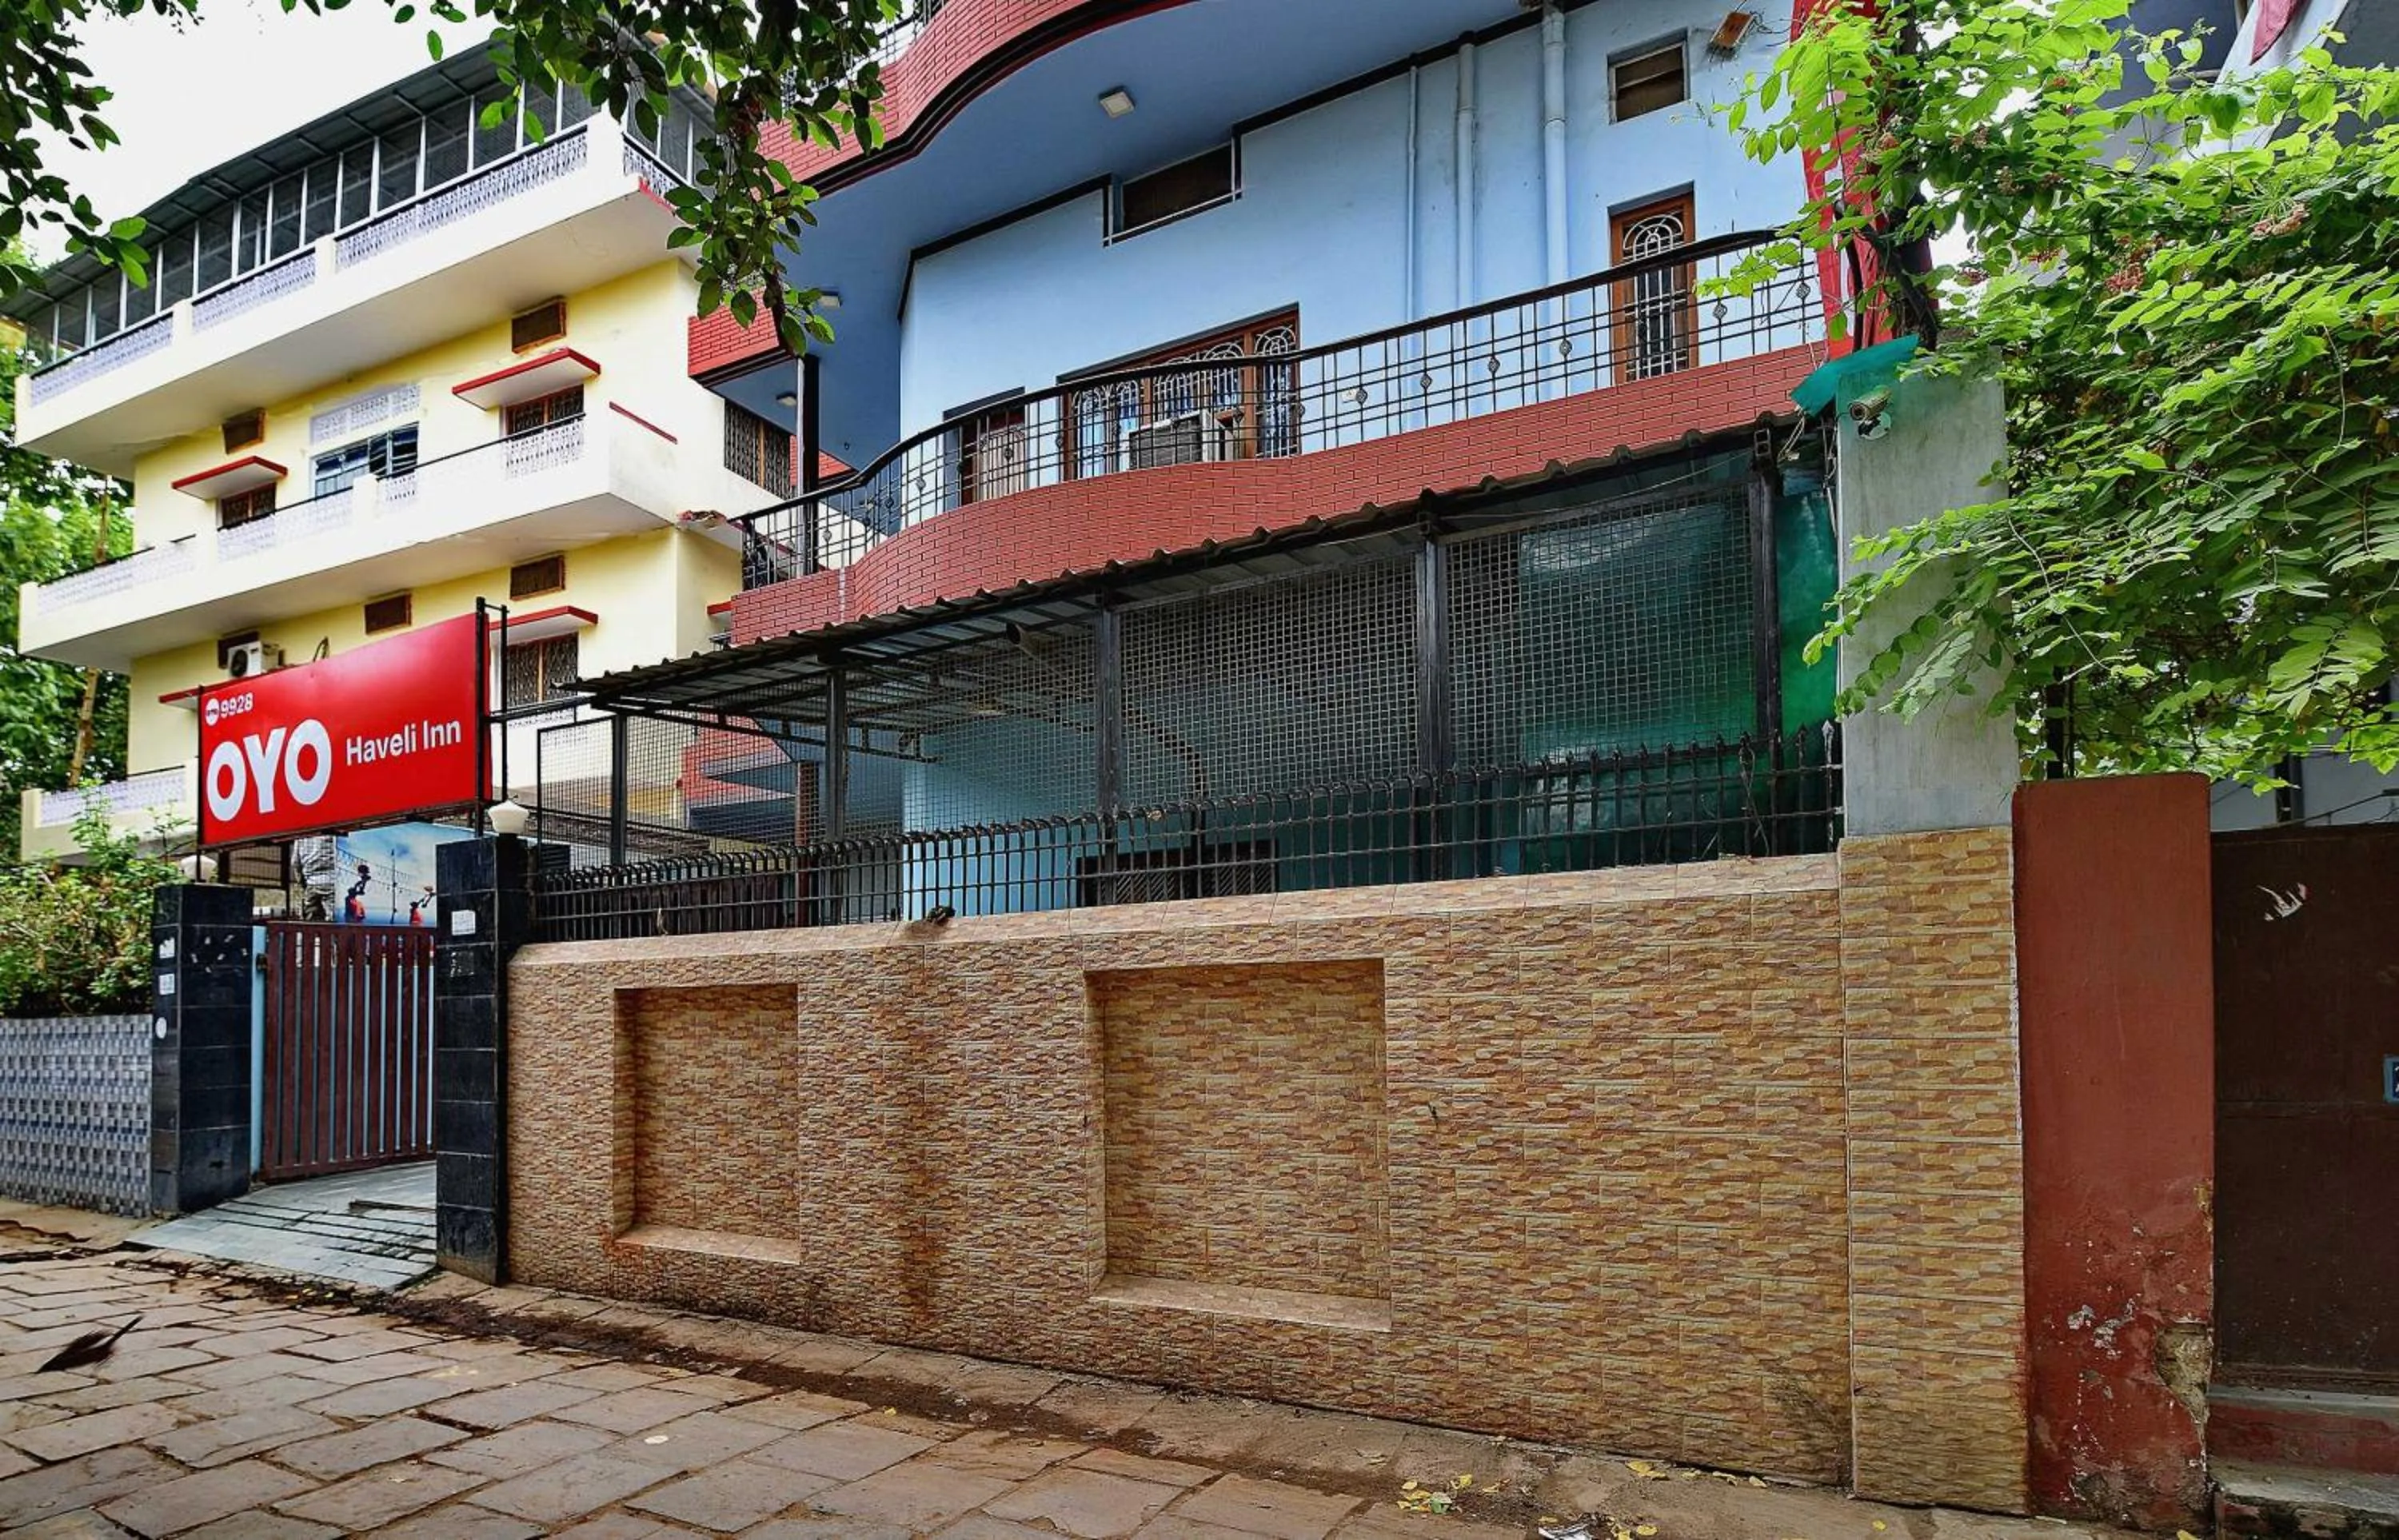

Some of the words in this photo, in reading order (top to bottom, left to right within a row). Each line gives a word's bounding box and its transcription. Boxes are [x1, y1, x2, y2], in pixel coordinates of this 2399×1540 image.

[220, 692, 253, 719] 9928
[346, 723, 417, 766] Haveli
[423, 720, 461, 750] Inn
[206, 719, 333, 822] OYO
